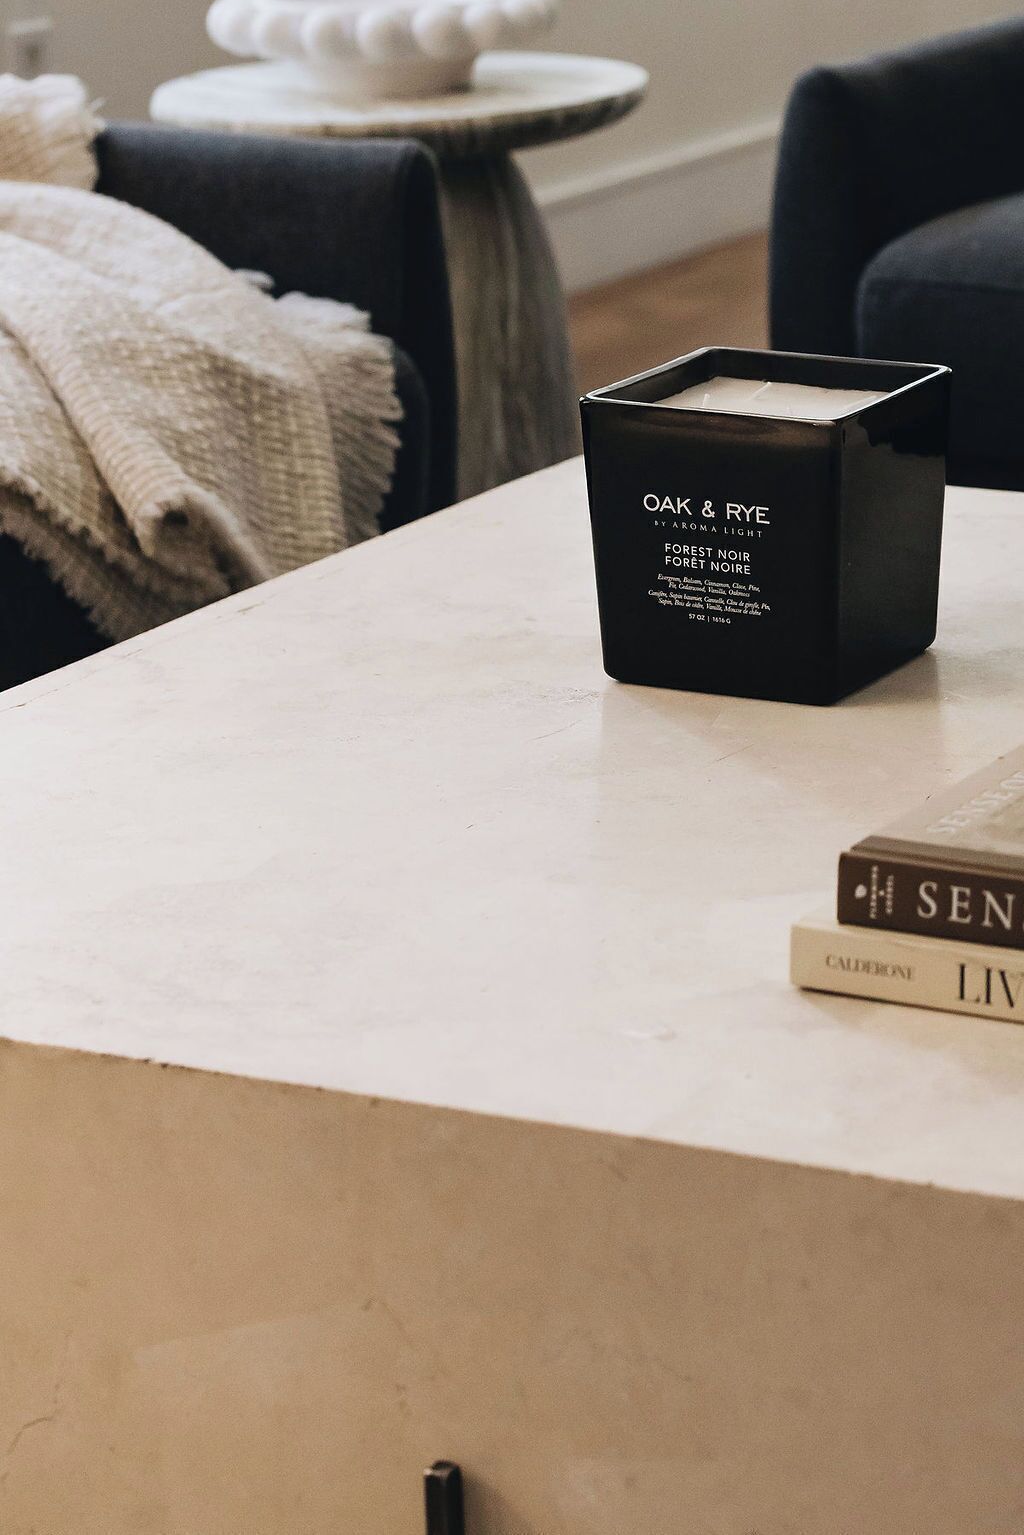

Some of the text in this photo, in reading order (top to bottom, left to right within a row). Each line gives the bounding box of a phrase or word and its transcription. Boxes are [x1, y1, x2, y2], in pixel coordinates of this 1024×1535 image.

[643, 493, 771, 525] OAK & RYE
[672, 521, 717, 533] AROMA
[724, 526, 763, 538] LIGHT
[664, 542, 751, 562] FOREST NOIR
[664, 555, 752, 575] FORÊT NOIRE
[824, 953, 915, 981] CALDERONE
